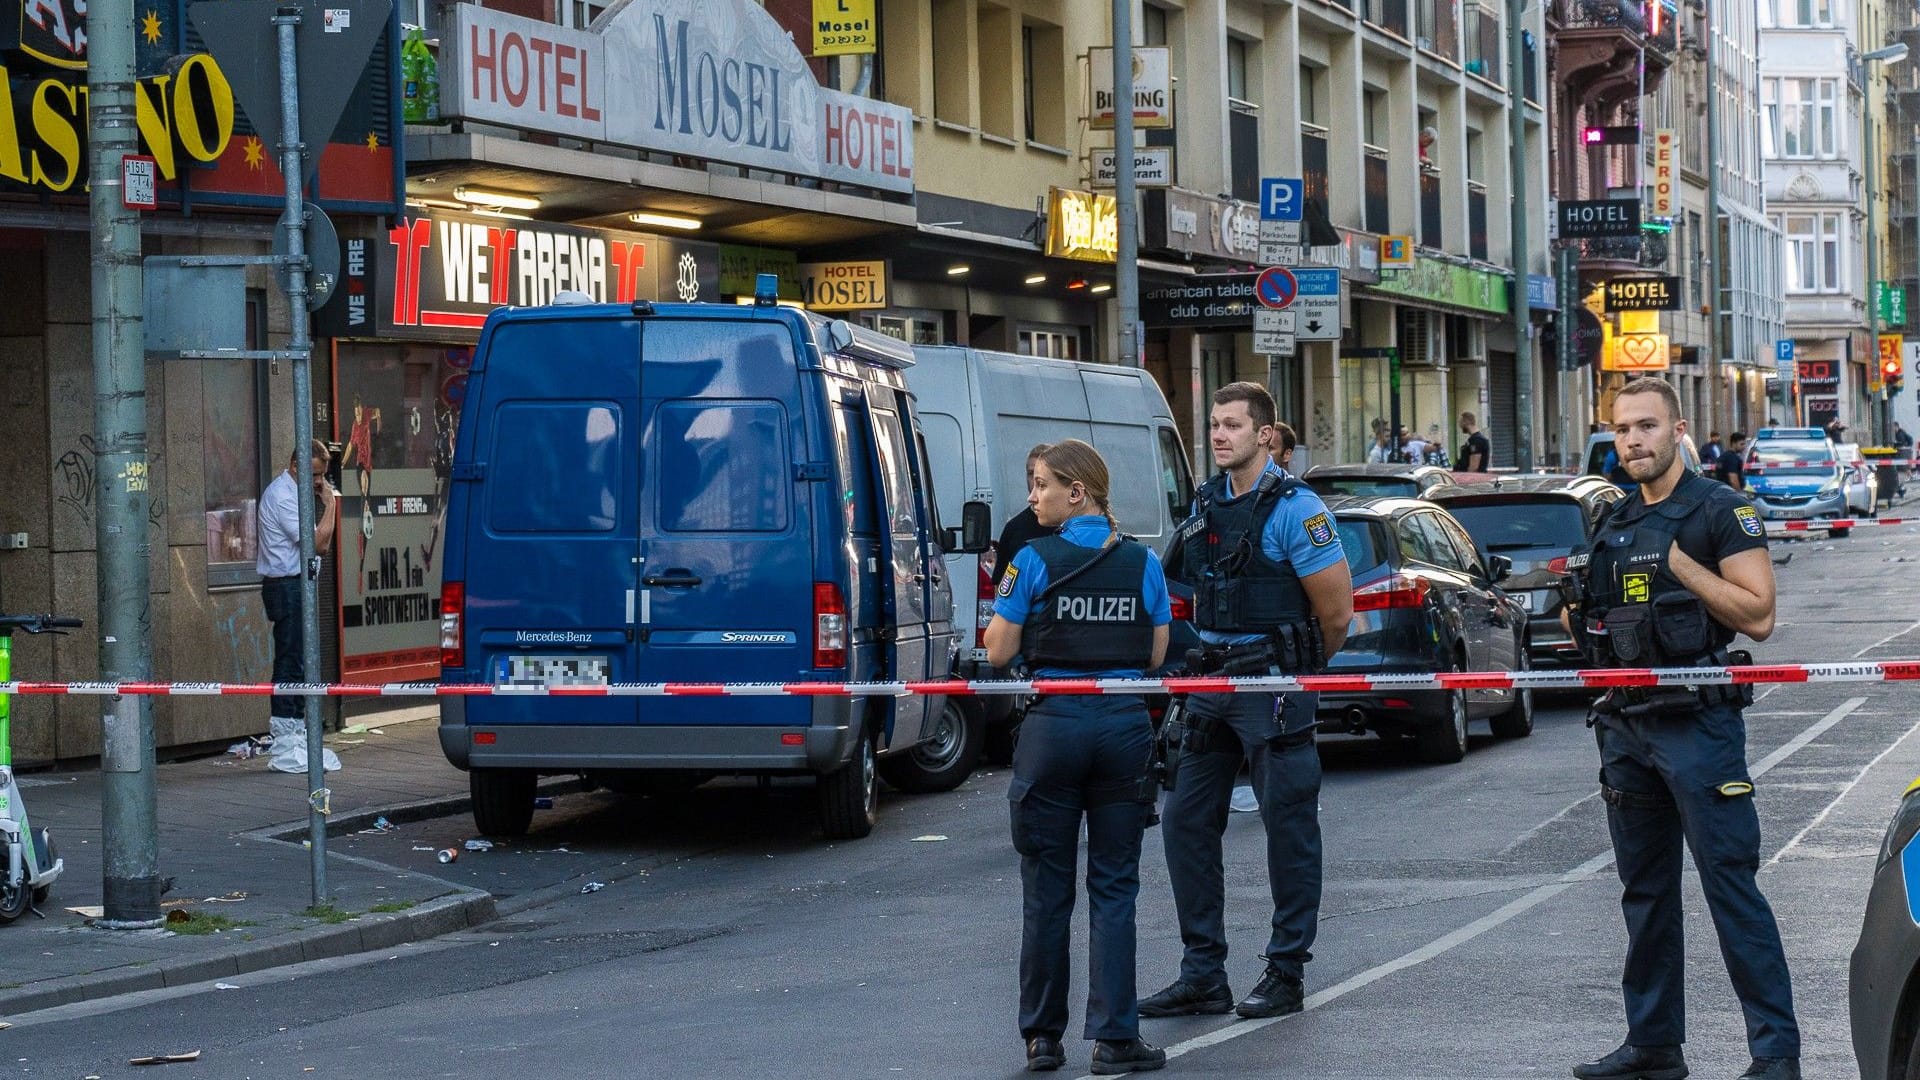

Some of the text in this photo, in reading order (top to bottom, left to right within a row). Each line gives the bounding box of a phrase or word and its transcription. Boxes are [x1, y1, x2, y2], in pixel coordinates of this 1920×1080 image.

[818, 18, 869, 33] Mosel
[471, 24, 601, 123] HOTEL
[1095, 88, 1165, 111] BIING
[824, 103, 912, 179] HOTEL
[1102, 156, 1158, 168] Olpia-
[1658, 149, 1670, 212] EROS
[1269, 183, 1293, 215] P
[1567, 206, 1629, 222] HOTEL
[1567, 222, 1629, 233] forty four
[1266, 245, 1277, 254] Mo
[1284, 246, 1292, 254] Fr
[824, 265, 876, 279] HOTEL
[1295, 273, 1335, 282] ARKSCHEIN-
[800, 275, 885, 307] MOSEL
[1146, 284, 1213, 301] american
[1299, 283, 1328, 292] AUTOMAT
[1611, 282, 1670, 300] HOTEL
[1304, 298, 1338, 308] Parkschein
[1611, 297, 1670, 309] forty four
[1170, 304, 1200, 319] club
[1780, 342, 1791, 358] P
[1181, 517, 1206, 541] POLIZEI
[367, 545, 425, 591] DIE NR. 1 FÜR
[1565, 552, 1590, 569] POLIZEI
[364, 591, 430, 627] SPORTWETTEN
[1056, 595, 1137, 621] POLIZEI
[515, 630, 593, 643] Mercedes-Benz
[720, 631, 787, 642] SPRINTER
